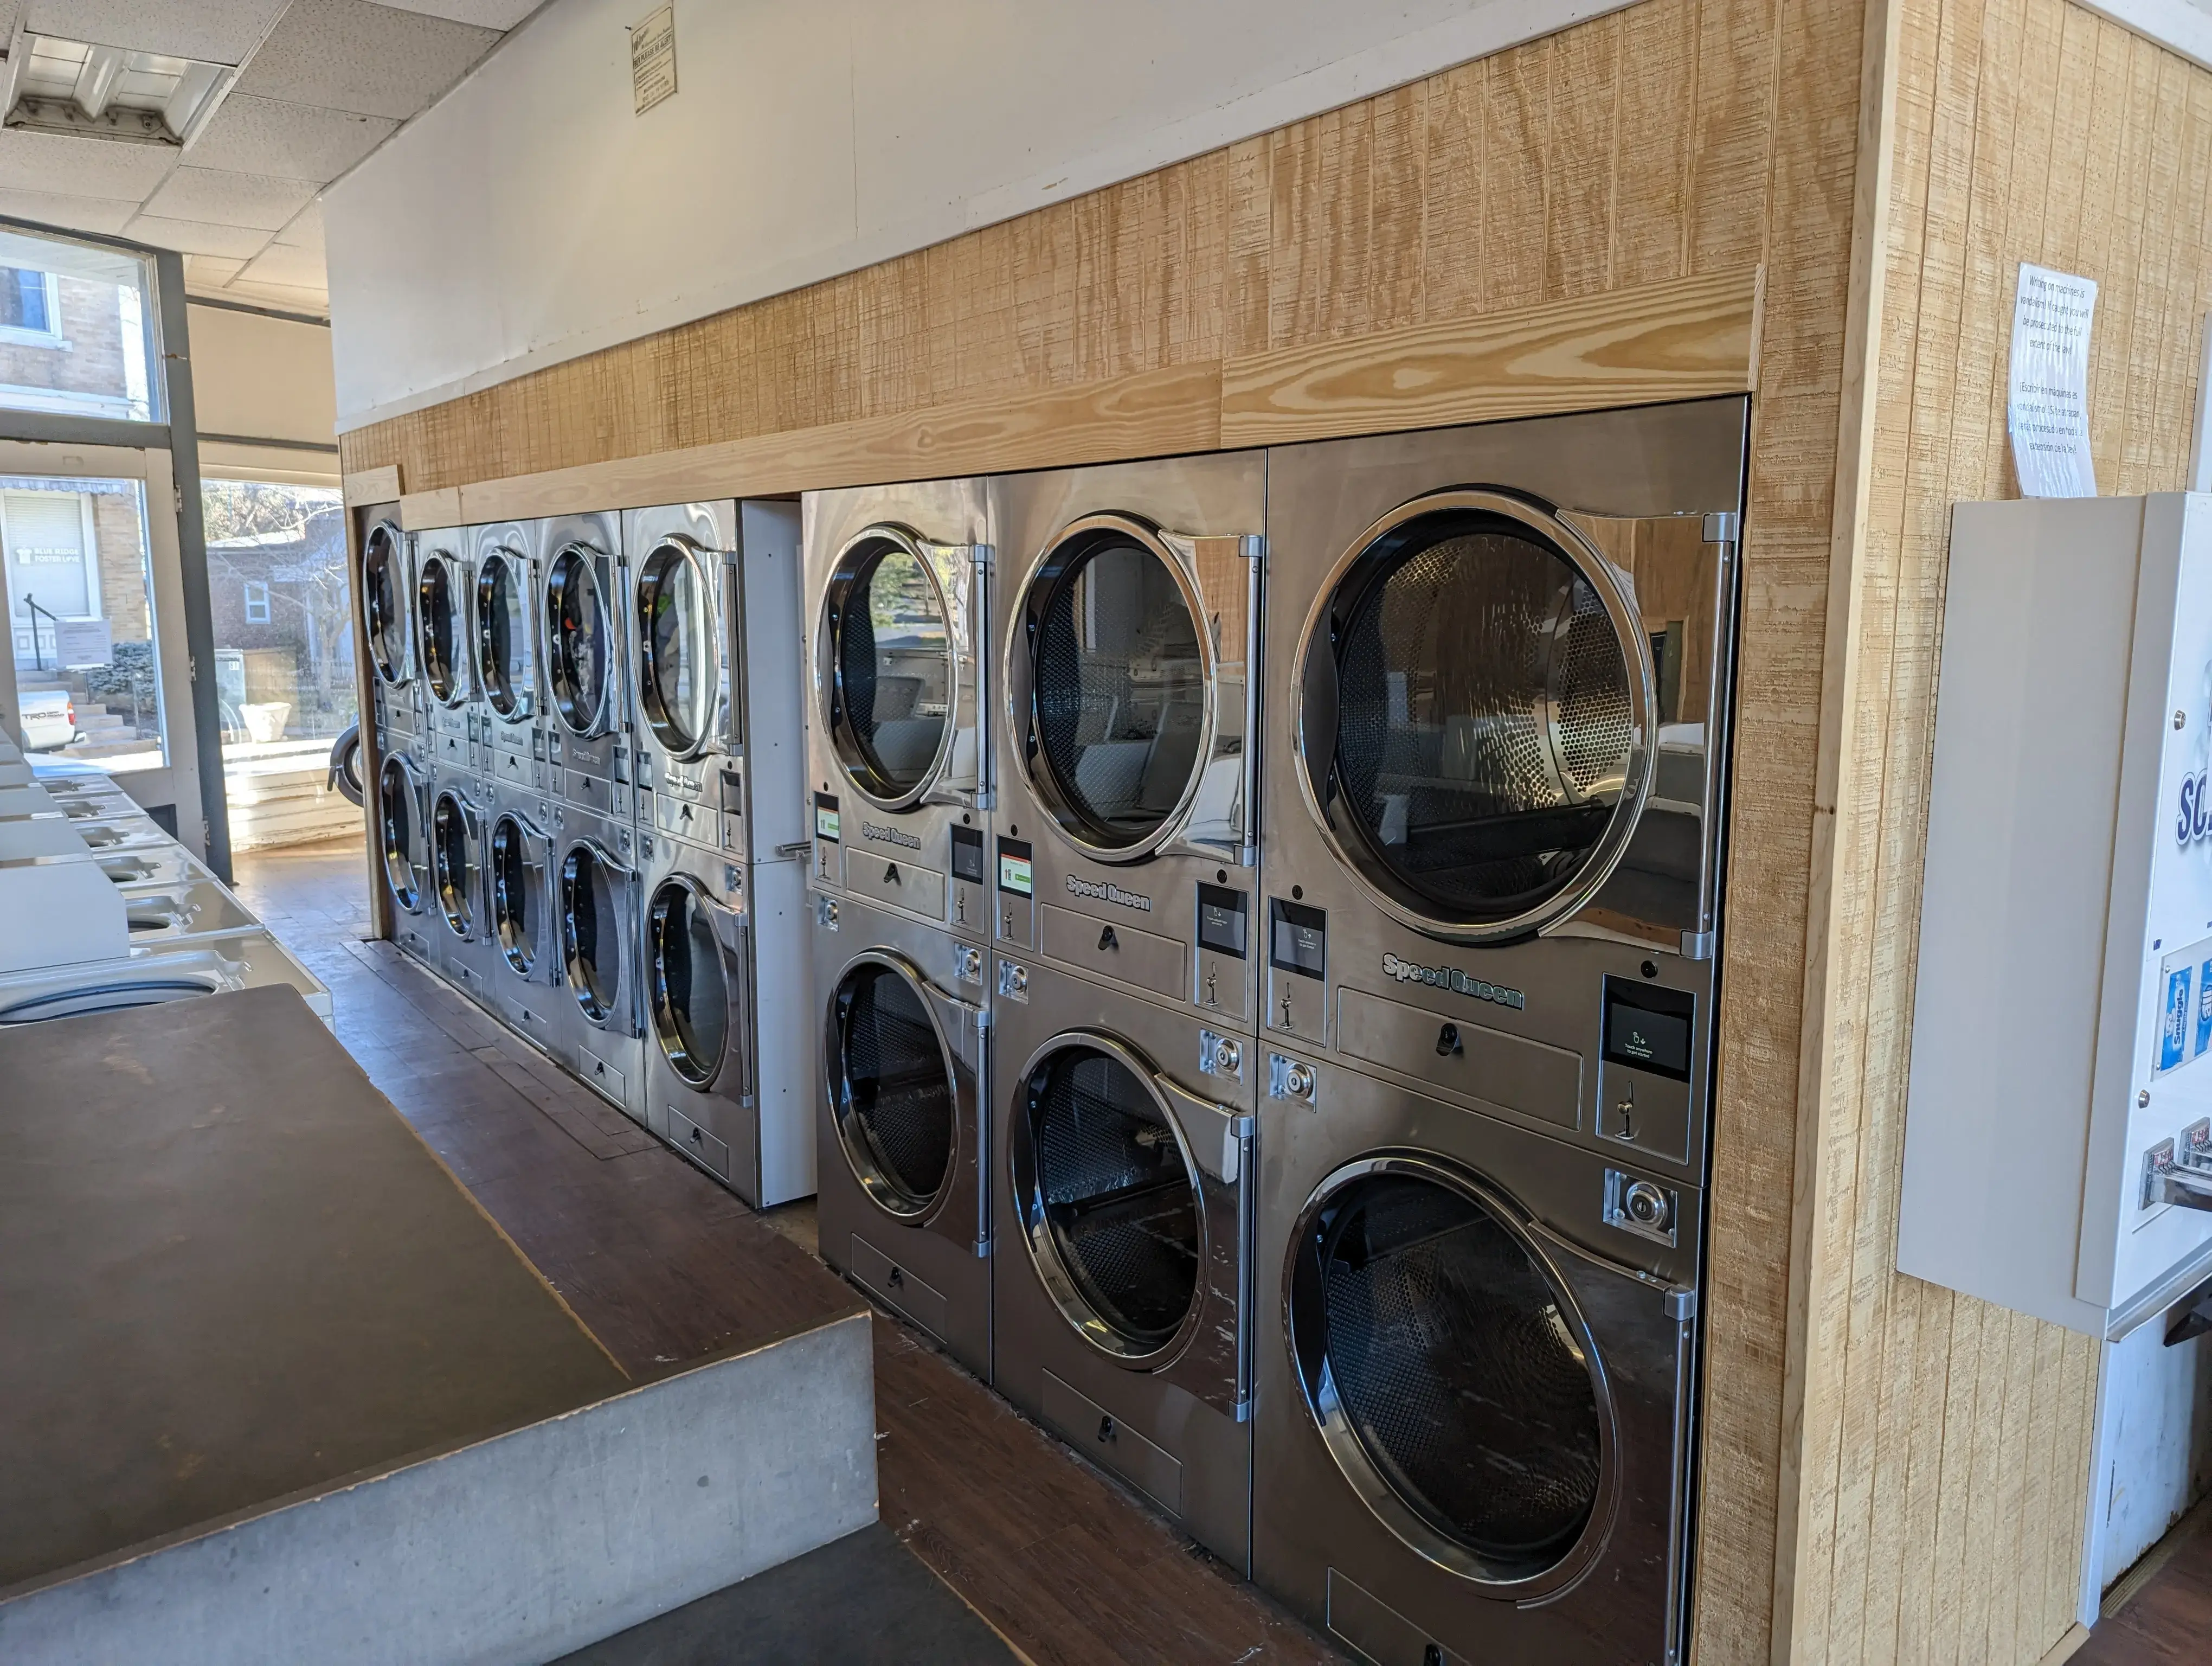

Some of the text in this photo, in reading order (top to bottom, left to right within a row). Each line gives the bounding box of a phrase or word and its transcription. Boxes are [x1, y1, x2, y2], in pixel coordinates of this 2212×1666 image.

[641, 47, 654, 61] PLEASE
[2030, 275, 2085, 298] Writing on machines is
[2021, 296, 2089, 318] vandalism! If caught you will
[2023, 315, 2082, 337] be prosecuted to the full
[2029, 339, 2072, 355] extent of the law!
[2041, 387, 2047, 395] en
[2048, 386, 2071, 399] máquinas
[2055, 407, 2061, 416] te
[2029, 442, 2054, 452] extensión
[2055, 443, 2061, 453] de
[2061, 443, 2067, 453] la
[2177, 774, 2212, 842] SO
[863, 821, 921, 850] Speed Queen
[1066, 874, 1152, 912] Speed Queen
[1382, 952, 1525, 1010] Speed Queen
[2174, 988, 2184, 1045] Snuggle
